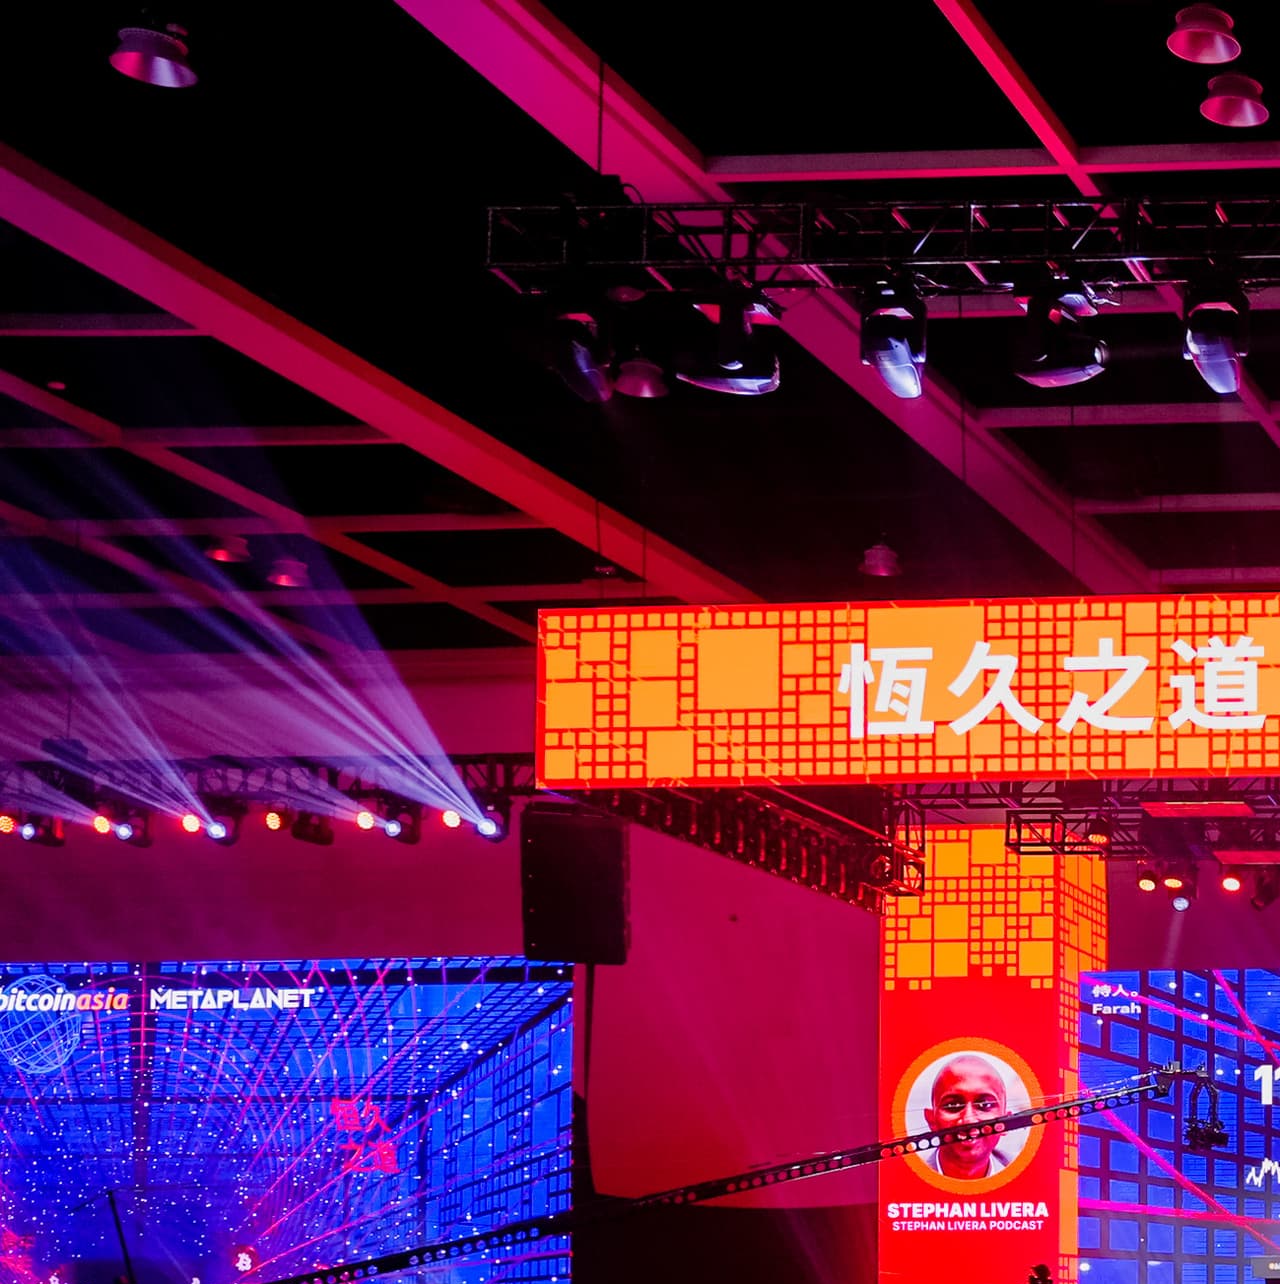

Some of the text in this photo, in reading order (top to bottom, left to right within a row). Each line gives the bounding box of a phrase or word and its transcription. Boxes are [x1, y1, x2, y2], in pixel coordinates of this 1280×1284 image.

[837, 635, 1267, 738] 恆久之道
[150, 988, 315, 1010] METAPLANET
[1092, 1002, 1141, 1015] Farah
[887, 1202, 1049, 1218] STEPHAN LIVERA
[892, 1220, 1044, 1231] STEPHAN LIVERA PODCAST
